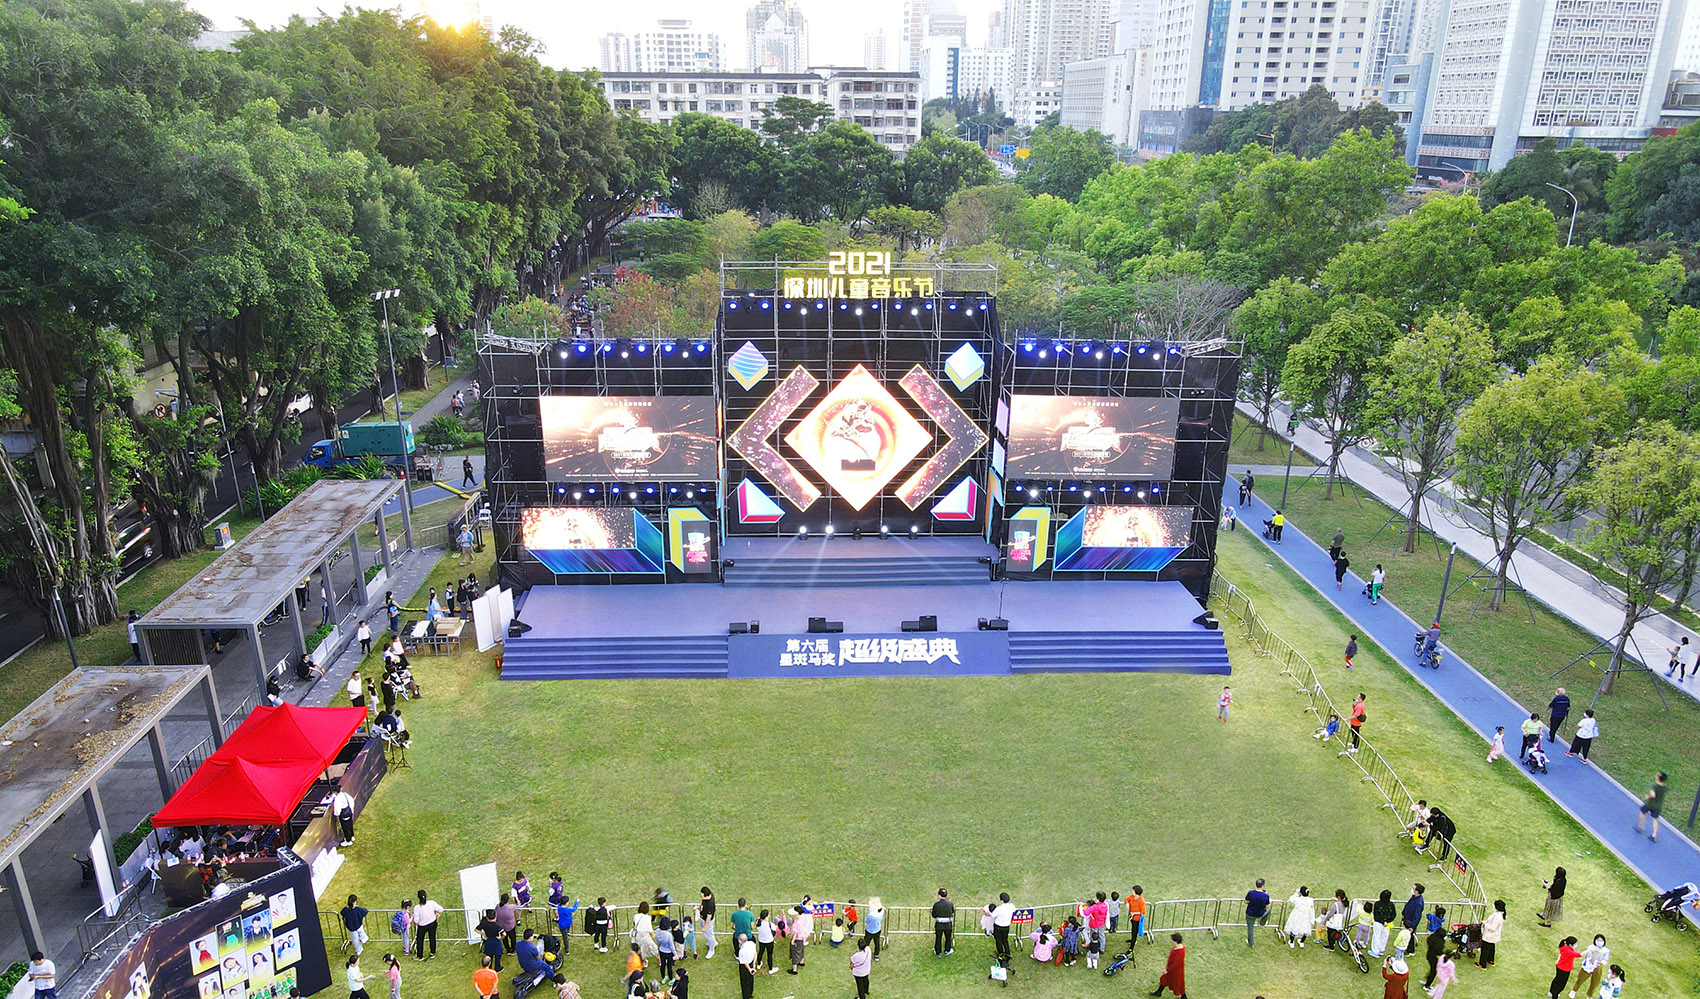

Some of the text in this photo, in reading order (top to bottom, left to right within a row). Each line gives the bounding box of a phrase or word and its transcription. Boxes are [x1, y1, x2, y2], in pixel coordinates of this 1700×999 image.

[828, 251, 891, 275] 2021
[783, 277, 934, 299] 深圳儿童音乐节
[786, 639, 829, 653] 第六届
[838, 638, 961, 667] 超级盛典
[779, 653, 836, 667] 星斑马奖
